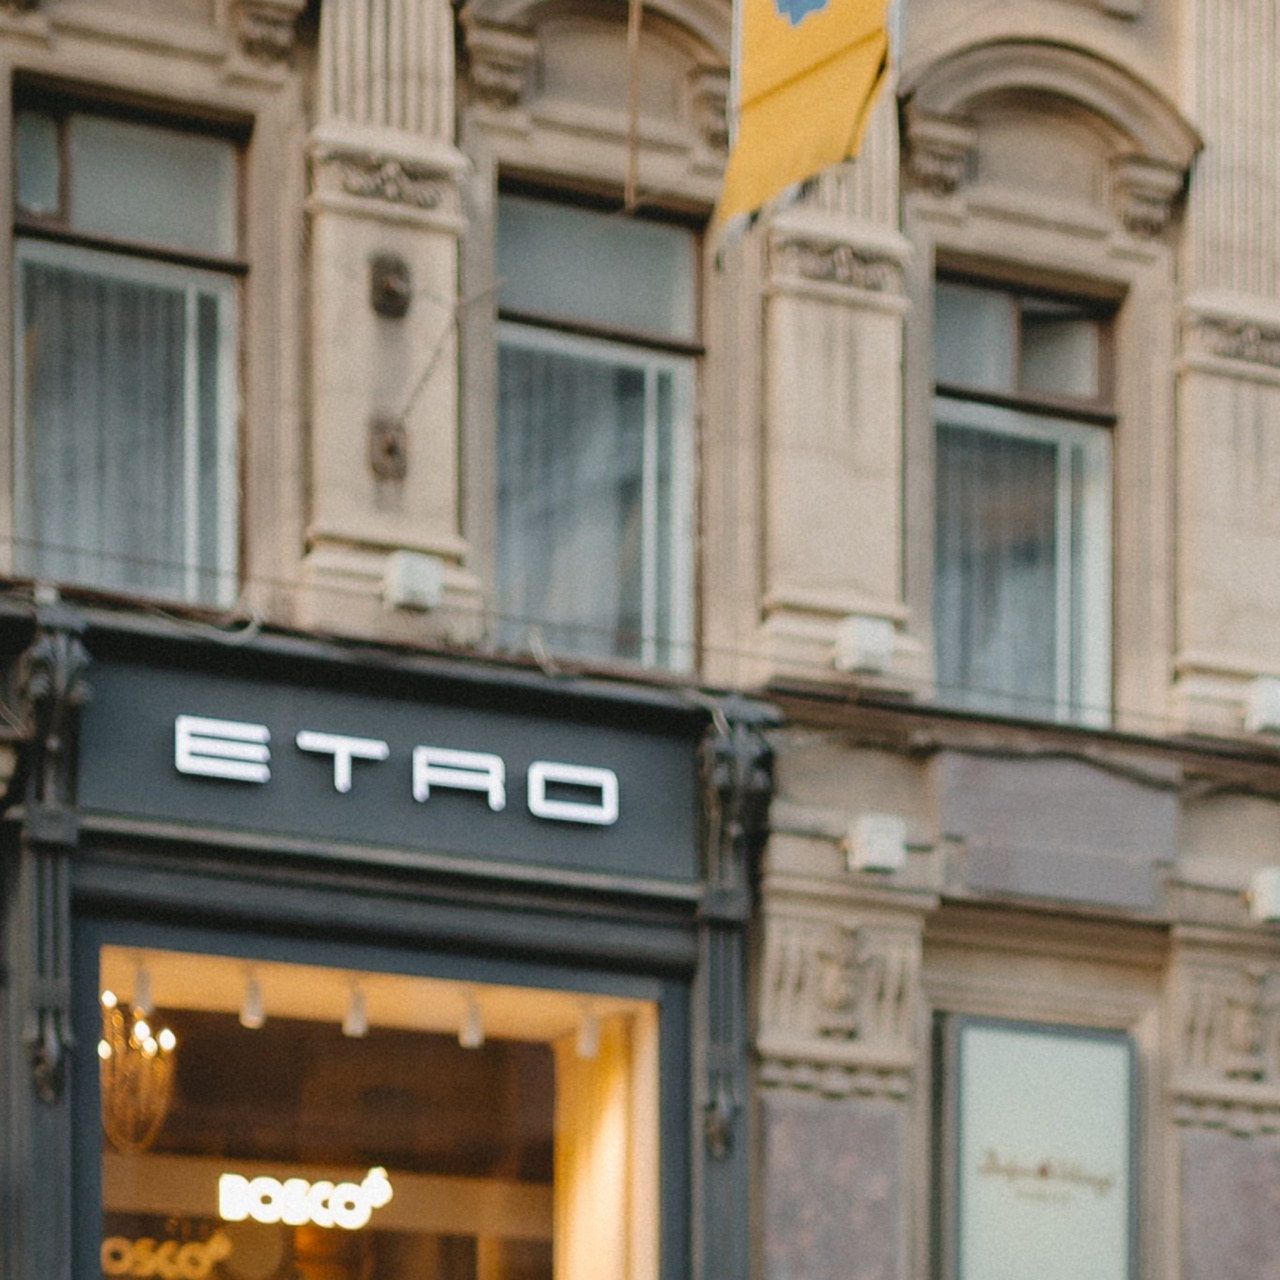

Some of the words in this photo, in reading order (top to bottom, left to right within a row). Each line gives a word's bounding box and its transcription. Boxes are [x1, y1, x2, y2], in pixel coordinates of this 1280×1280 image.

[174, 714, 619, 826] ETRO
[218, 1172, 373, 1231] BOSCO
[100, 1236, 216, 1280] OSCO
